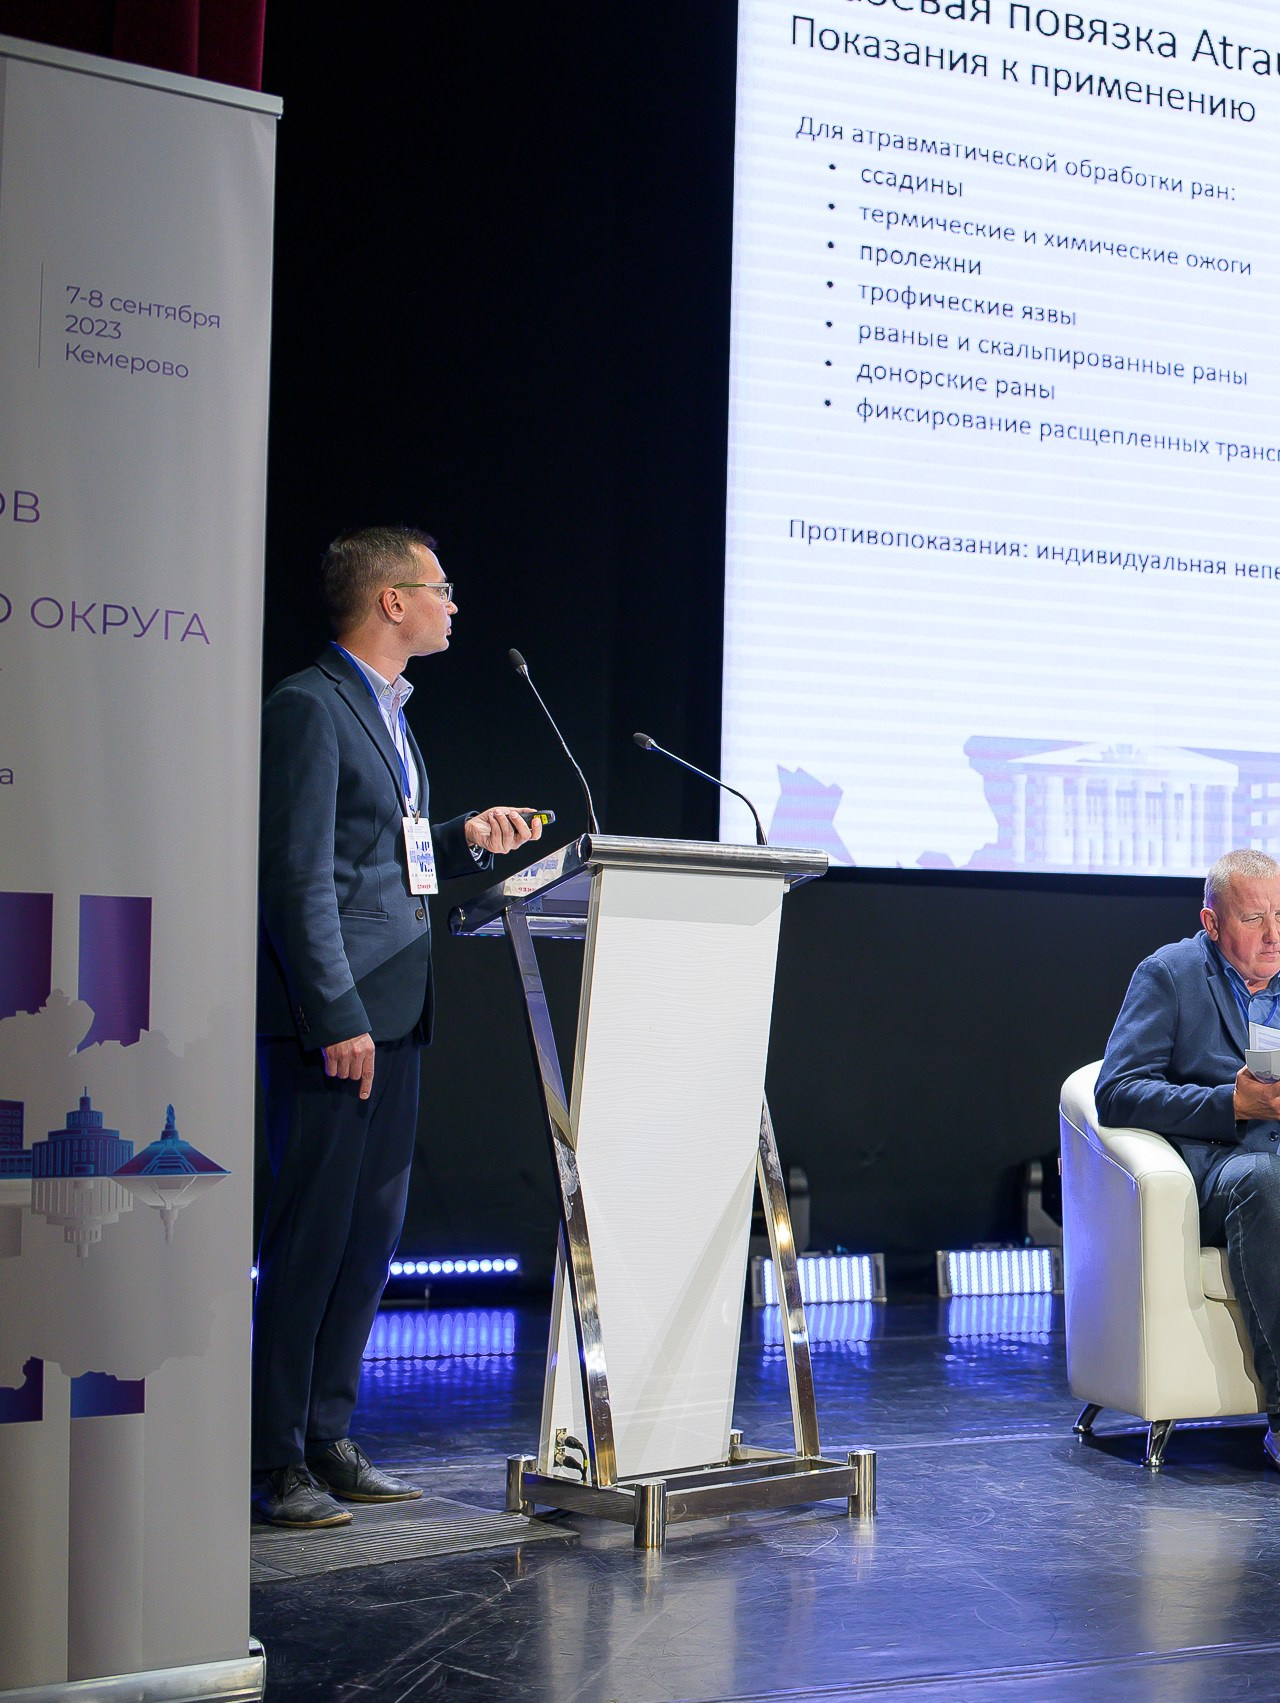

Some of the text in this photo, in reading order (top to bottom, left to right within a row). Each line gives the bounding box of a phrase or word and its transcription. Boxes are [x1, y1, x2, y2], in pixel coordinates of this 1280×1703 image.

[1009, 3, 1177, 59] повязка
[792, 15, 1256, 123] Показания к применению
[796, 116, 1237, 200] Для атравматической обработки ран:
[861, 168, 963, 198] ссадины
[860, 206, 1251, 276] термические и химические ожоги
[860, 244, 981, 276] пролежни
[65, 315, 123, 341] 2023
[66, 286, 222, 333] 7-8 сентября
[860, 284, 1077, 326] трофические язвы
[66, 343, 190, 380] Кемерово
[858, 325, 1248, 386] рваные и скальпированные раны
[856, 363, 1056, 400] донорские раны
[856, 396, 1032, 434] фиксирование
[1040, 422, 1210, 455] расщепленных
[789, 519, 1029, 558] Противопоказания:
[1036, 545, 1226, 575] индивидуальная
[31, 597, 212, 646] ОКРУГА
